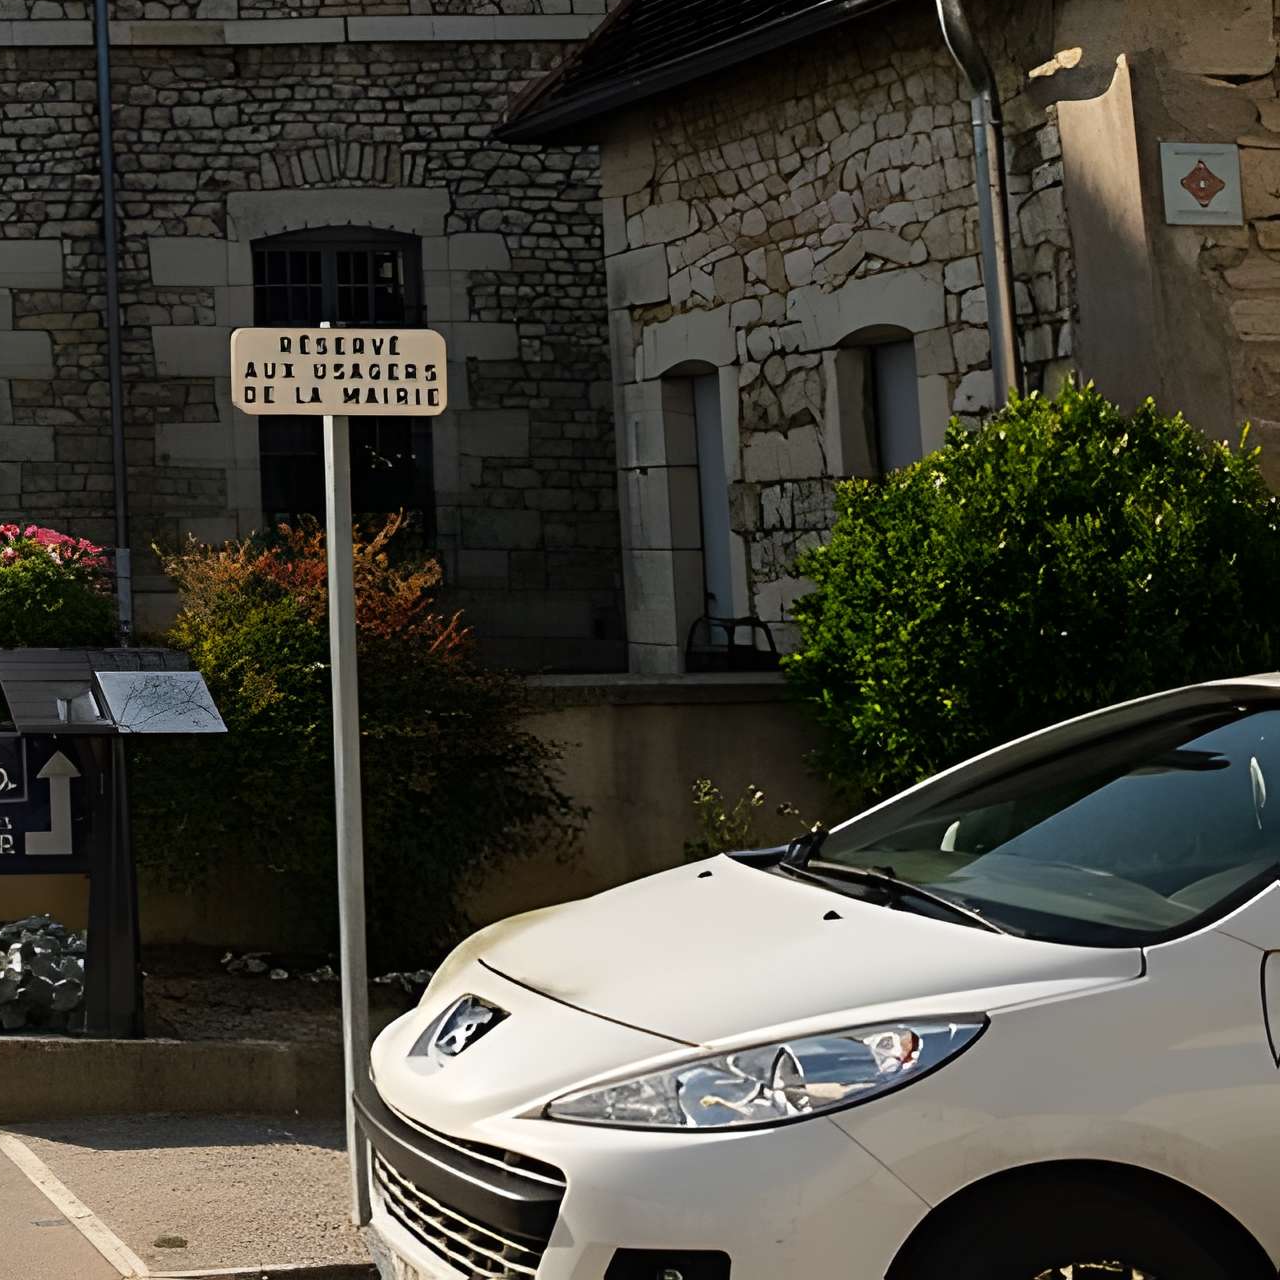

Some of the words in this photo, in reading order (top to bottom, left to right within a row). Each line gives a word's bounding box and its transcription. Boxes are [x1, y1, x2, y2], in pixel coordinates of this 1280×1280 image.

[245, 362, 295, 379] AUX
[314, 363, 437, 381] USAGERS
[244, 386, 275, 403] DE
[296, 387, 322, 403] LA
[343, 387, 439, 406] MAIRIE
